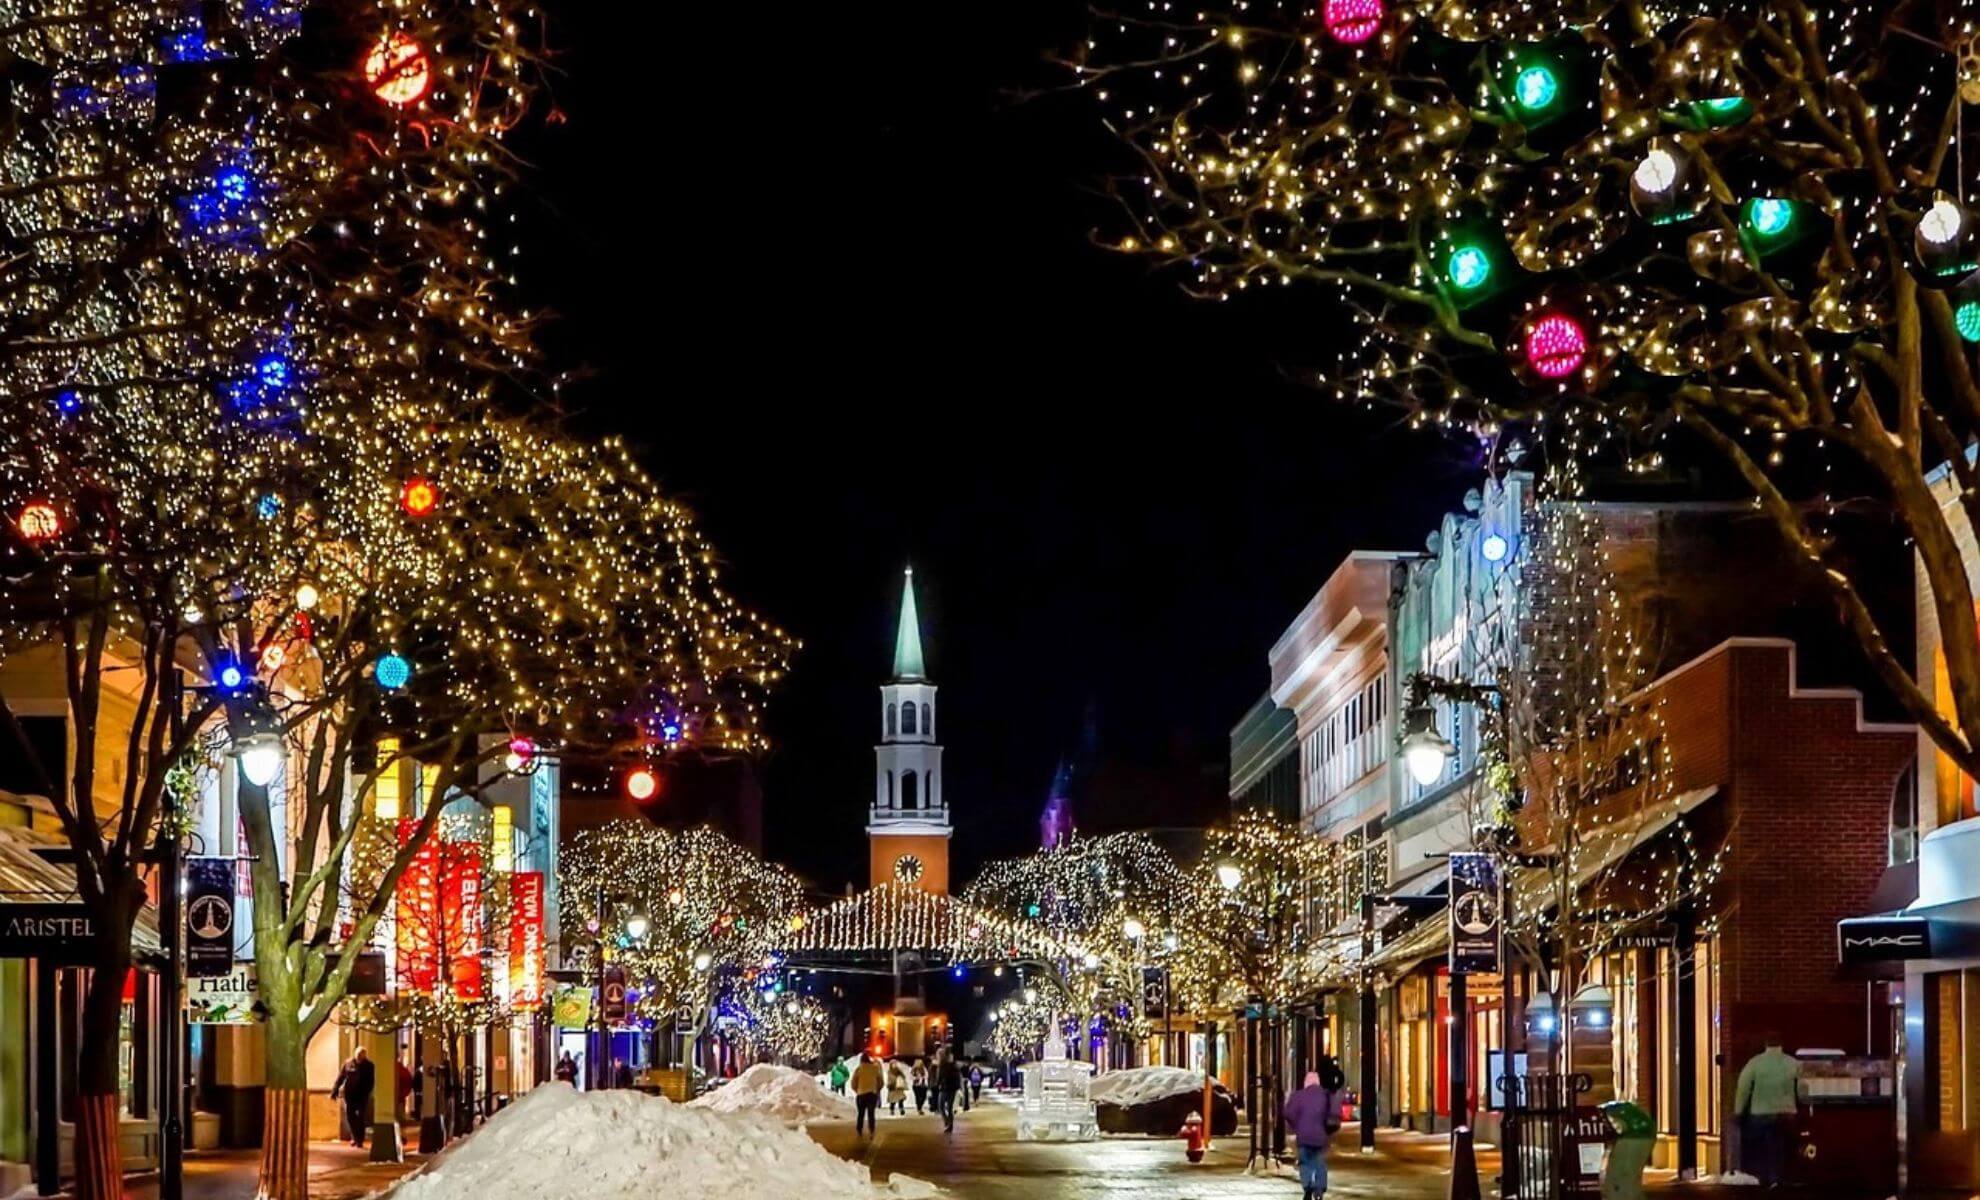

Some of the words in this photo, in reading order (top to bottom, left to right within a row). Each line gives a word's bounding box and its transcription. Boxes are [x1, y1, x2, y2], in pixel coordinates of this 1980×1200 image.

[524, 876, 538, 918] MALL
[5, 917, 96, 937] ARISTEL
[1845, 935, 1923, 948] MAC
[523, 923, 539, 1002] SHOPPING
